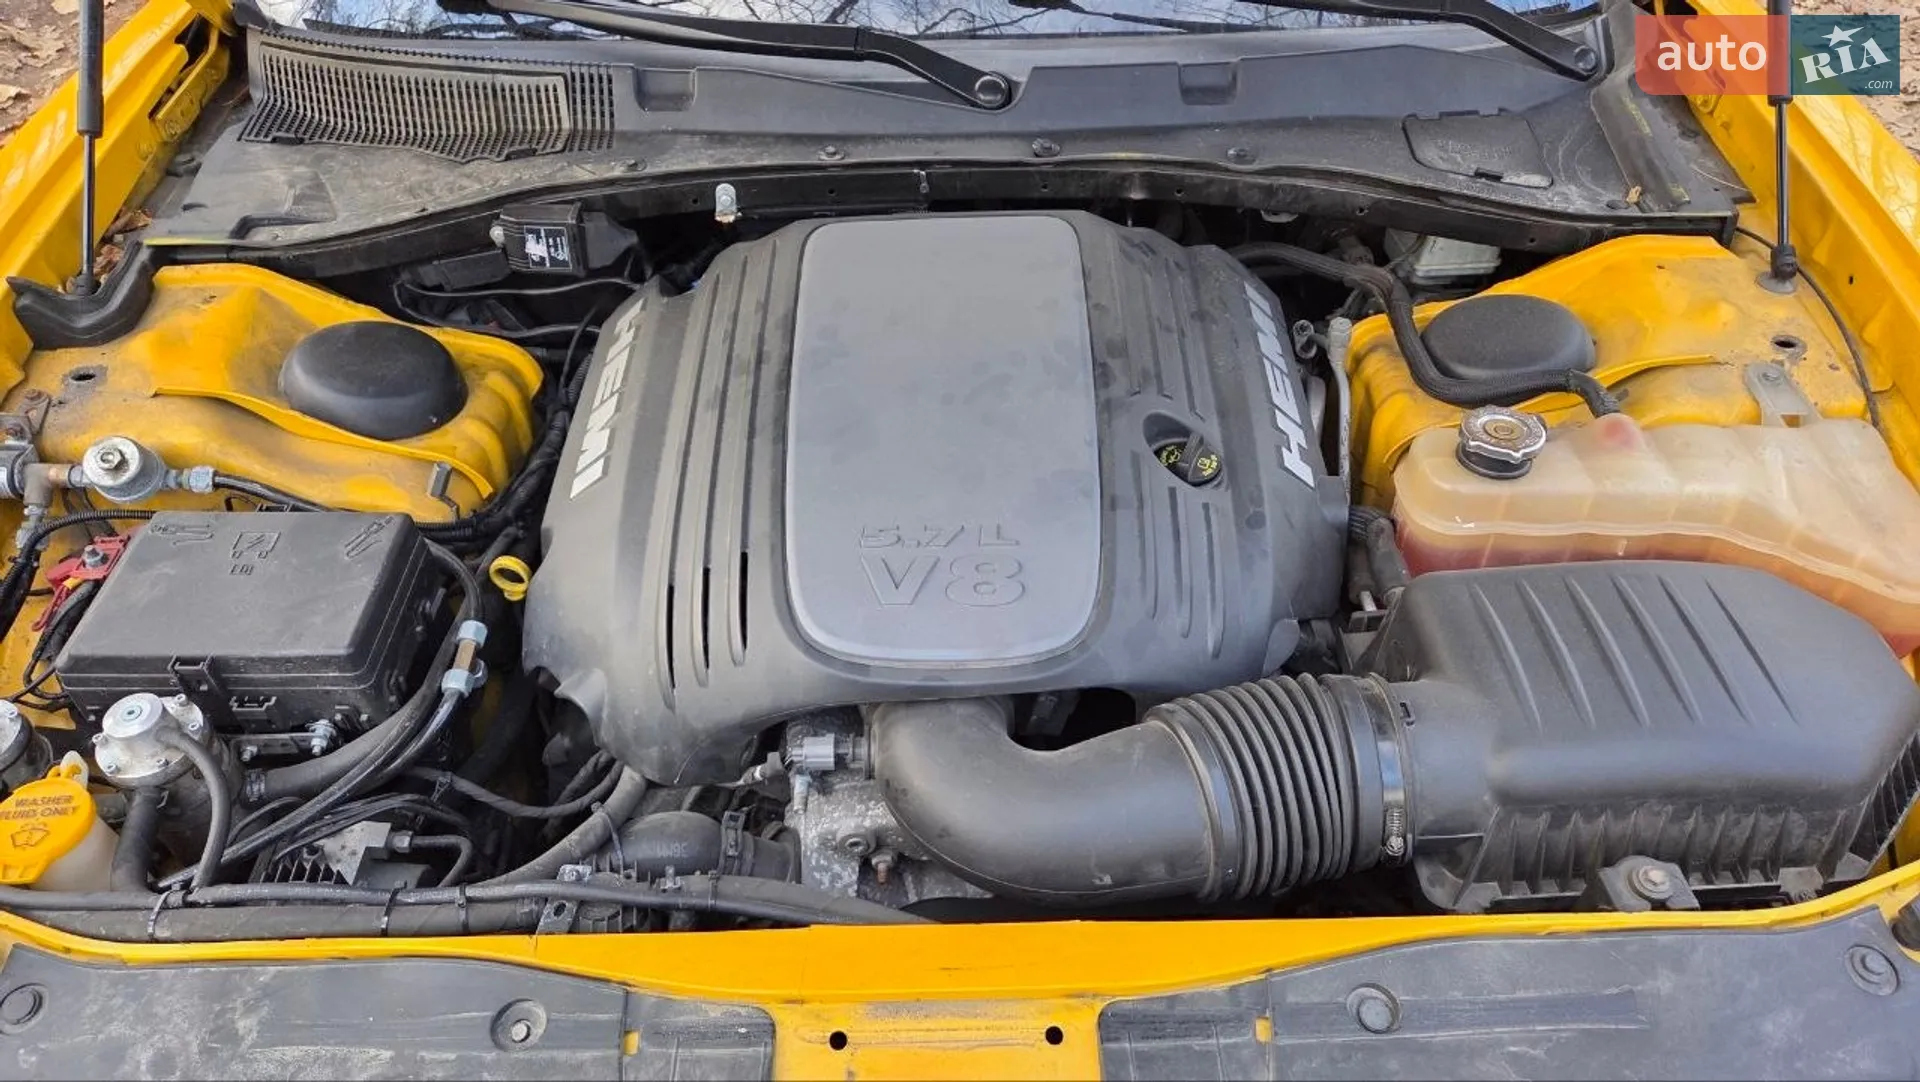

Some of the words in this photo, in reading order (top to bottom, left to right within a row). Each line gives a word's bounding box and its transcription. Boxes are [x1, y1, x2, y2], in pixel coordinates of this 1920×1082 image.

[570, 297, 645, 500] HEMI
[1244, 281, 1315, 488] HEMI
[860, 552, 1026, 608] V8
